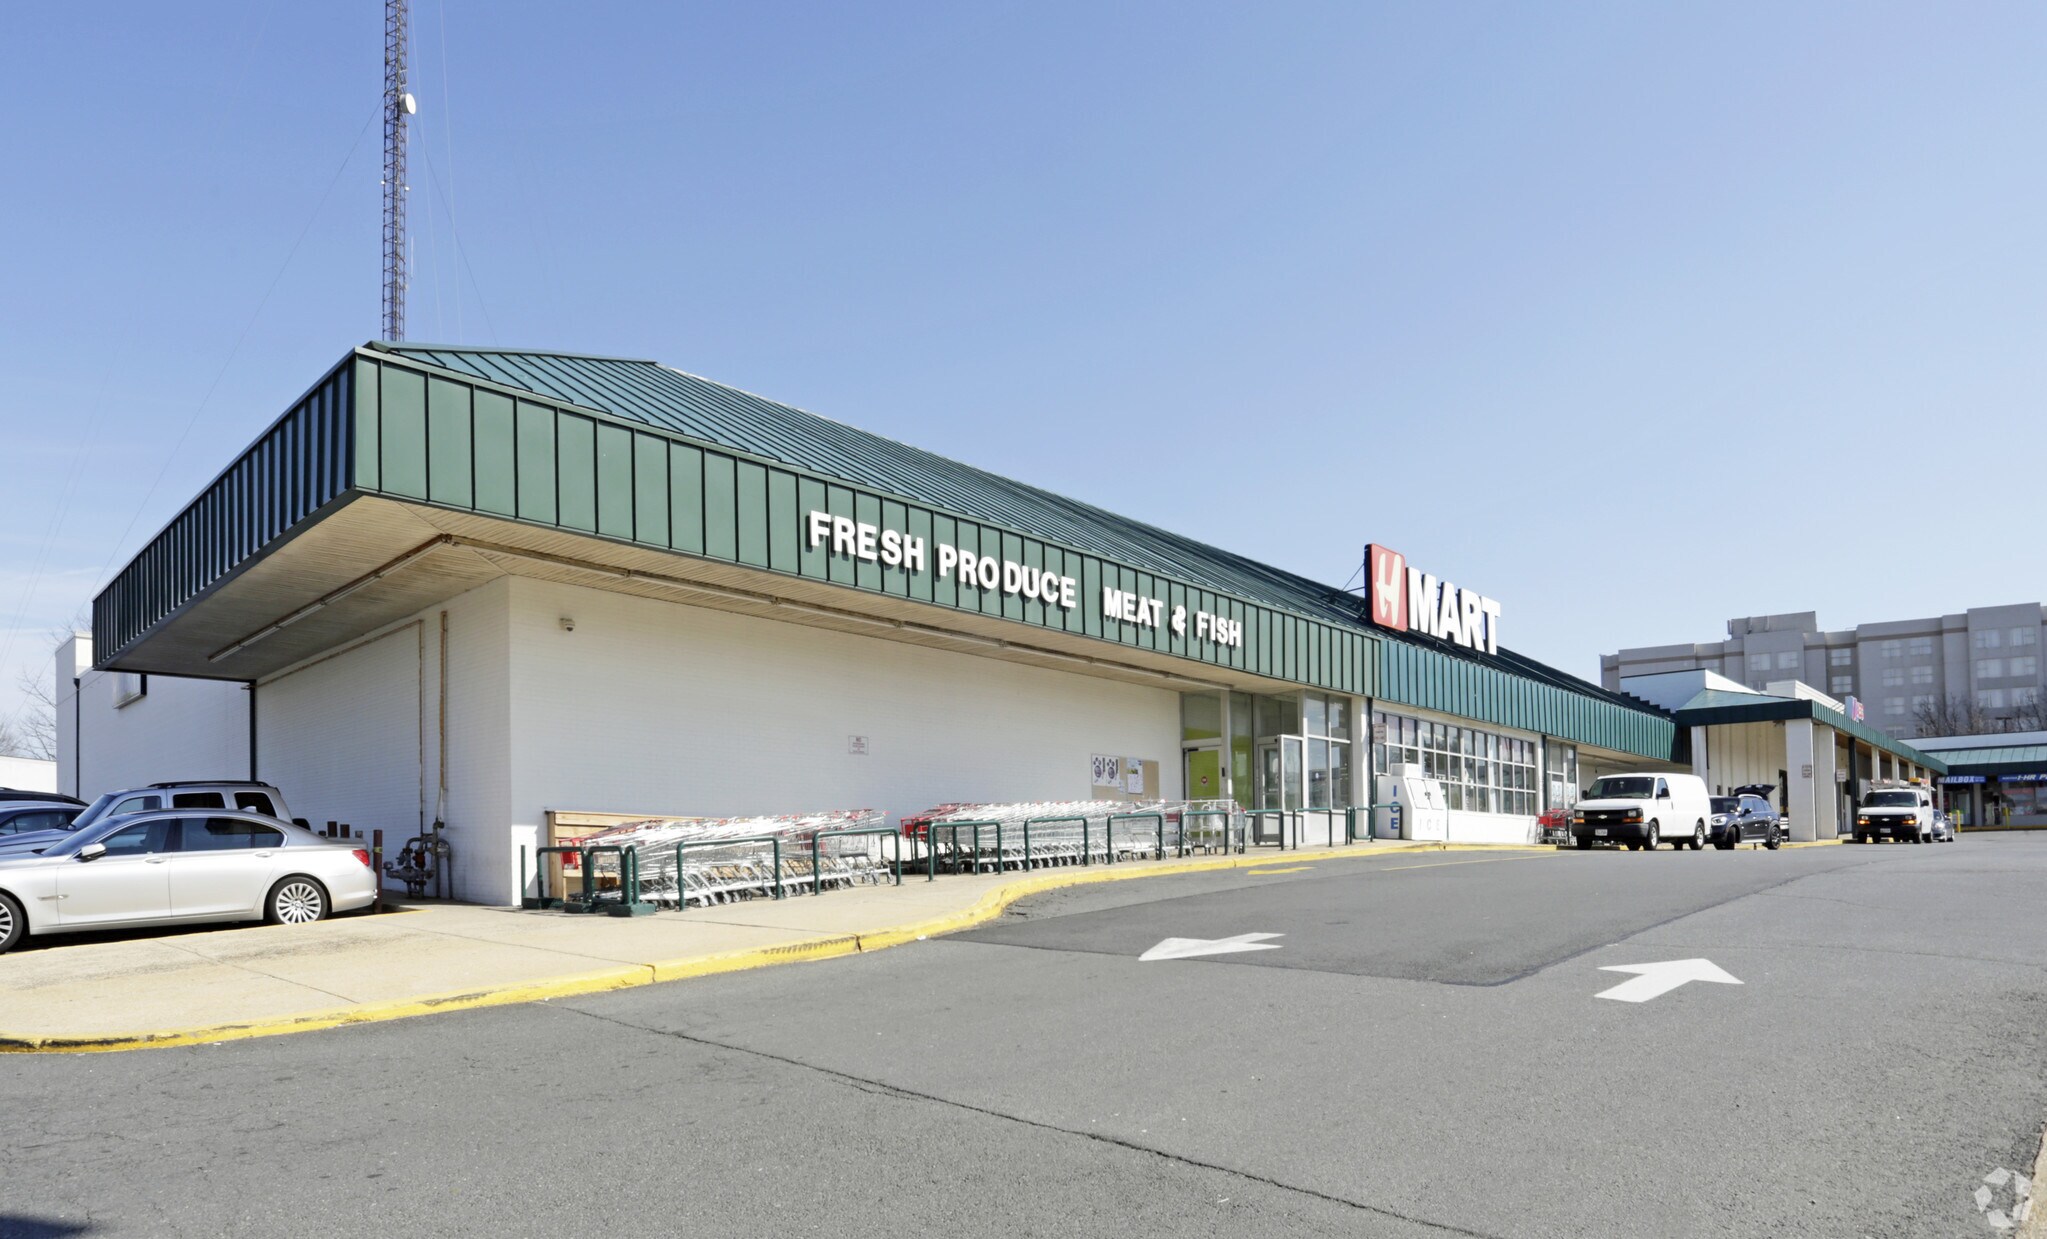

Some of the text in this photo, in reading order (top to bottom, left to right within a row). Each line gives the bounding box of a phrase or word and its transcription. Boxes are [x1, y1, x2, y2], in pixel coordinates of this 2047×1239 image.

[809, 510, 1243, 647] FRESH PRODUCE MEAT & FISH
[1376, 553, 1501, 655] H MART
[1937, 775, 1975, 784] MAILBOX
[1390, 785, 1400, 829] ICE
[1419, 818, 1440, 831] ICE
